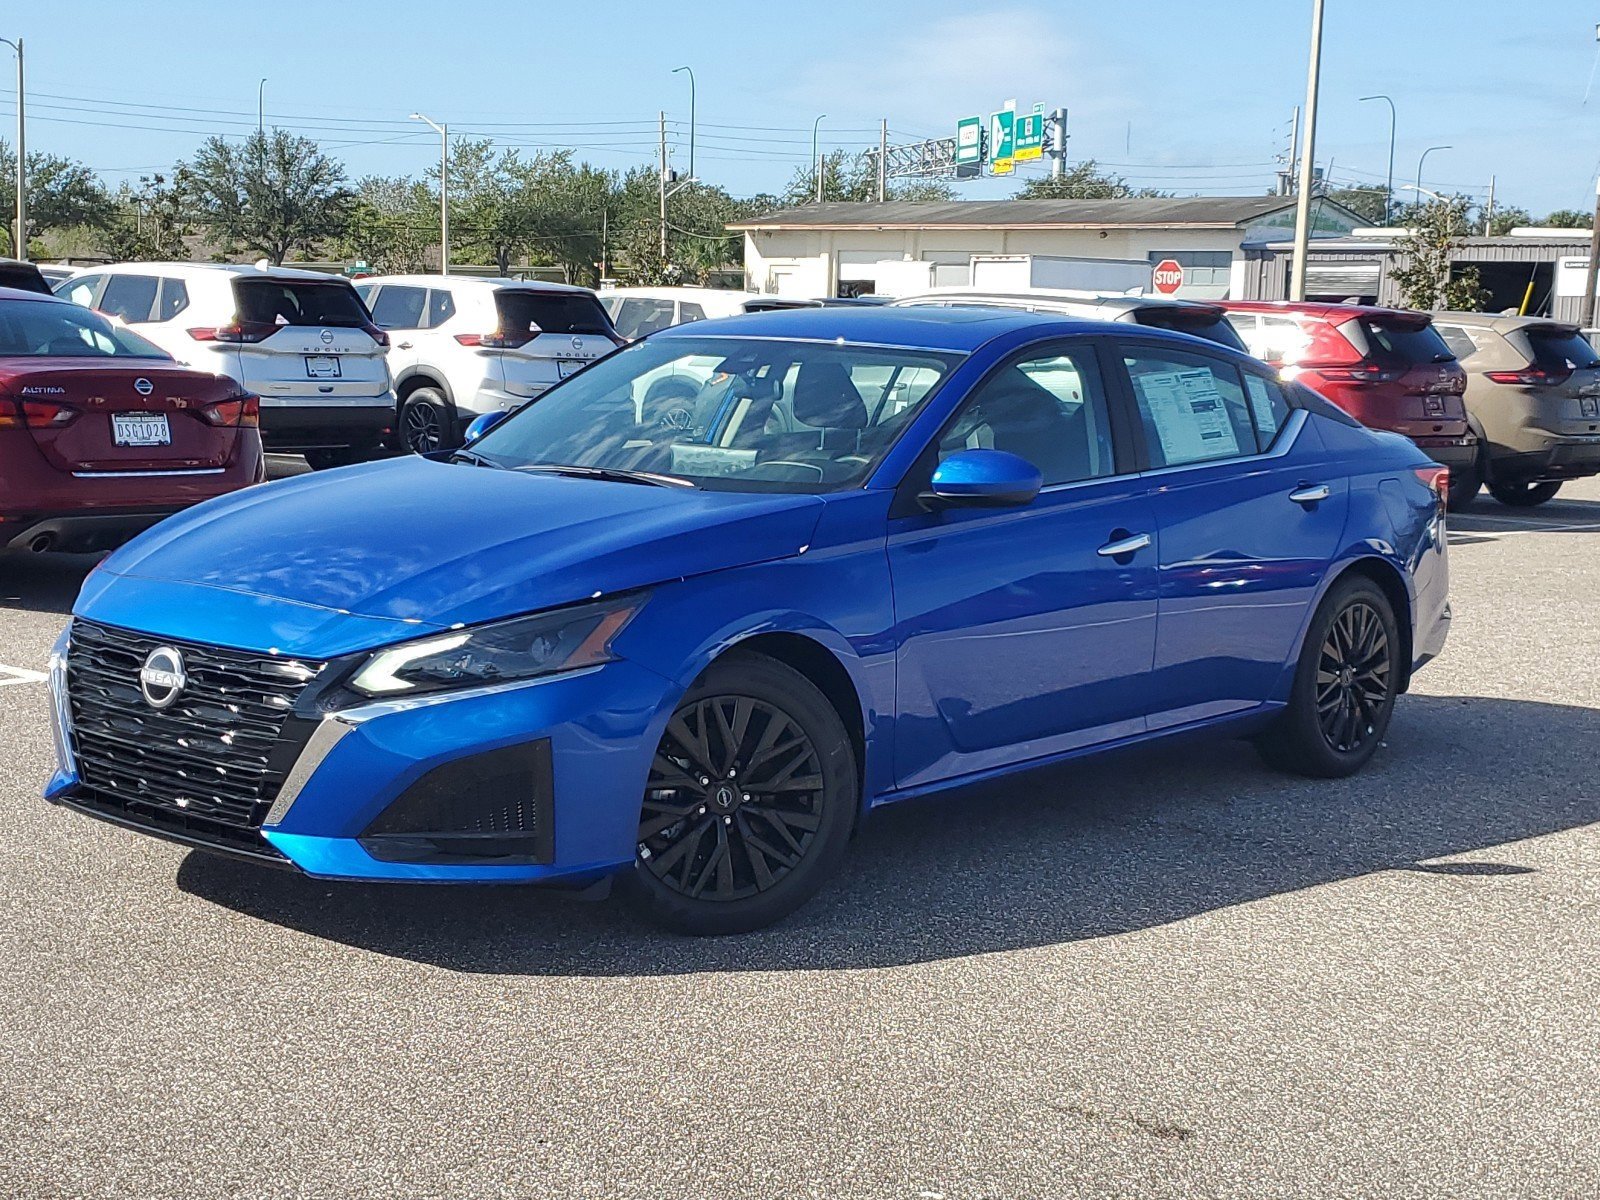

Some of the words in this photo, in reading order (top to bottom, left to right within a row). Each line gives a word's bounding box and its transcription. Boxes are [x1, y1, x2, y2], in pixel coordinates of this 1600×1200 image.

[1155, 270, 1181, 285] STOP
[21, 386, 66, 394] ALTIMA
[141, 669, 184, 687] NISSAN
